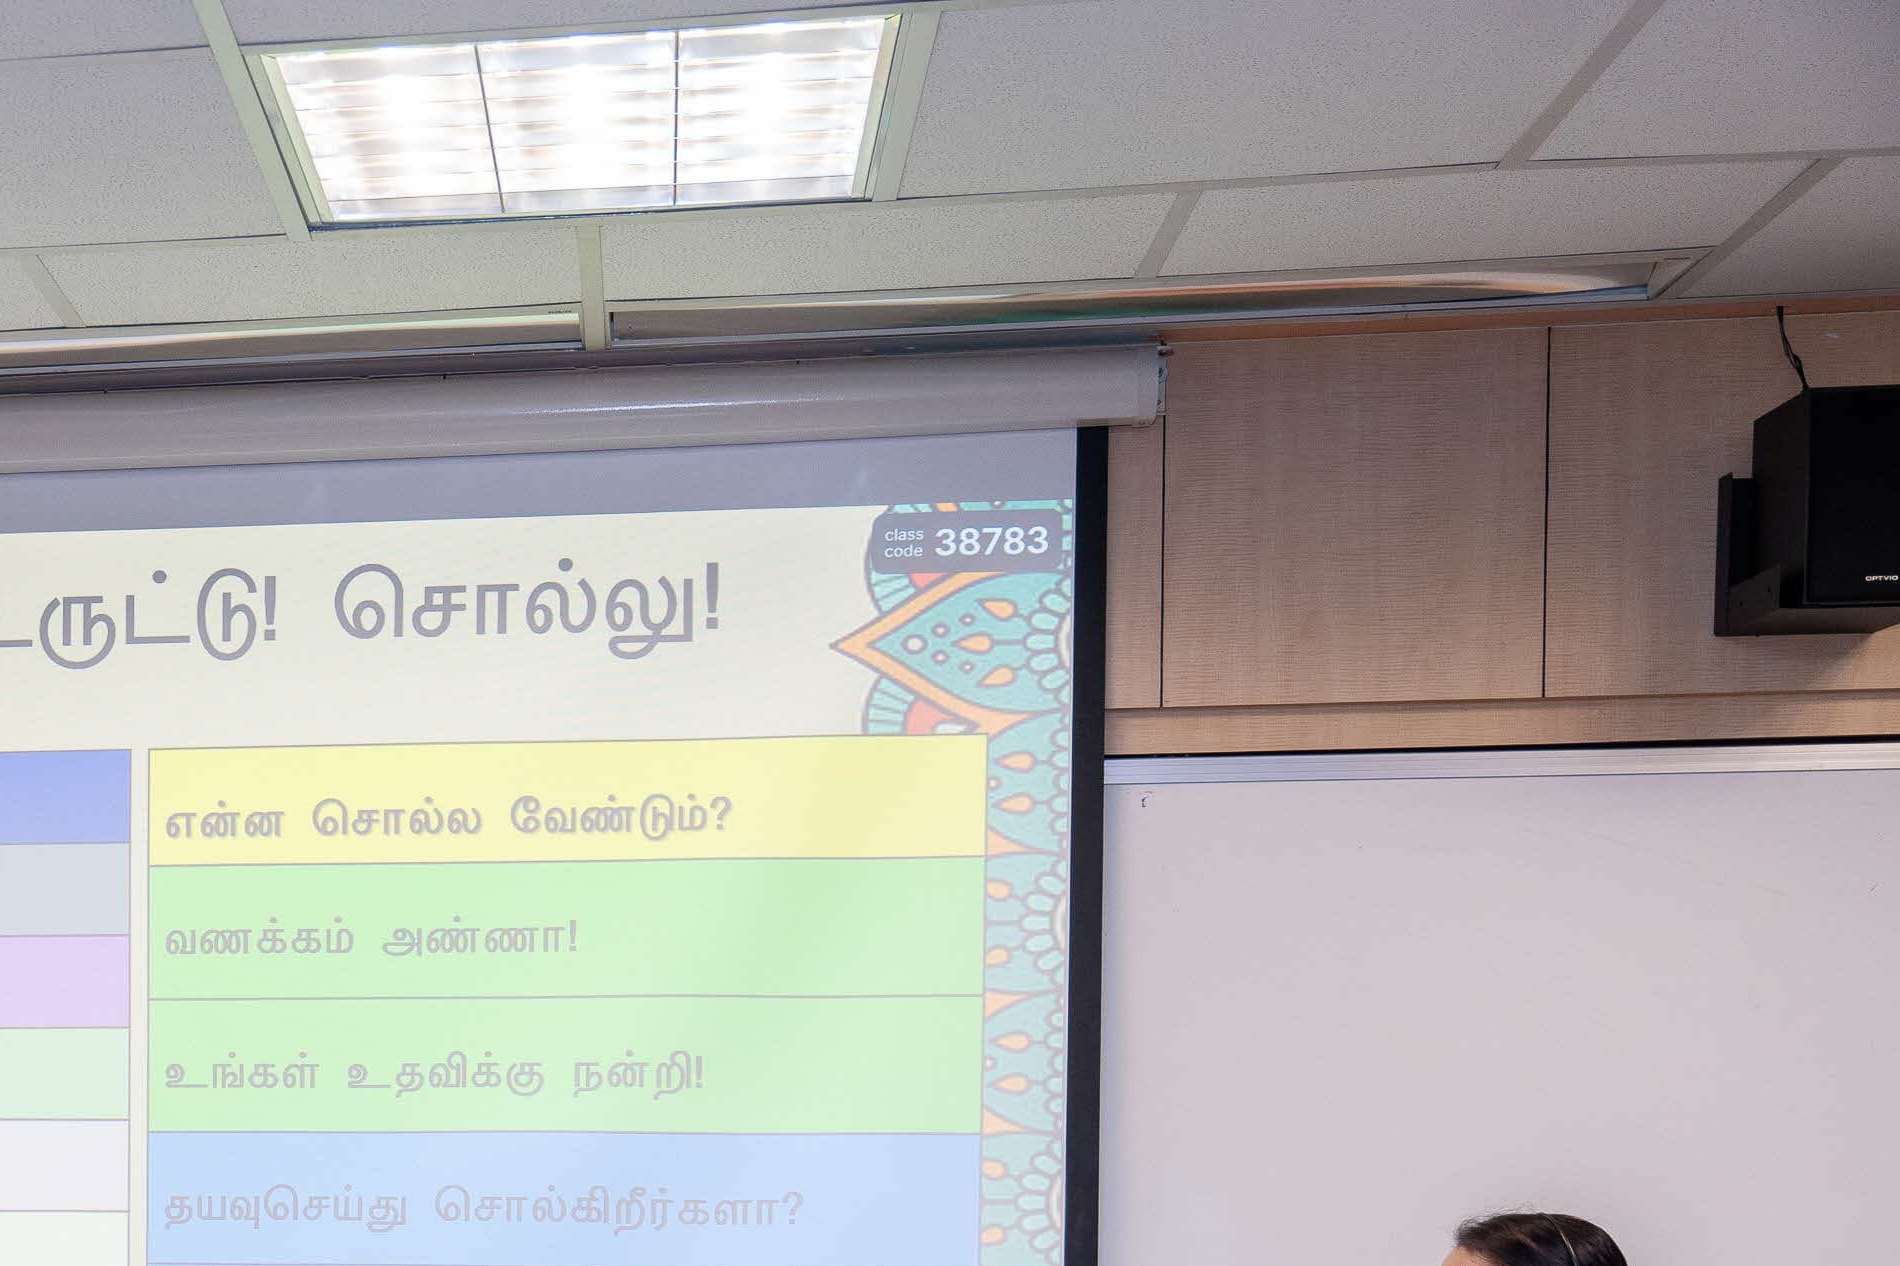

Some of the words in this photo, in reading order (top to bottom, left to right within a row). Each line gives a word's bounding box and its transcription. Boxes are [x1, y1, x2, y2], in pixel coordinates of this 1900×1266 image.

[884, 544, 924, 558] code
[885, 529, 924, 541] class
[936, 526, 1048, 556] 38783
[334, 558, 719, 659] சொல்லு!
[166, 800, 284, 838] என்ன
[312, 796, 482, 836] சொல்ல
[510, 793, 732, 841] வேண்டும்?
[165, 916, 354, 955] வணக்கம்
[382, 915, 577, 956] அண்ணா!
[165, 1052, 319, 1088] உங்கள்
[348, 1051, 544, 1098] உதவிக்கு
[574, 1050, 703, 1100] நன்றி!
[165, 1184, 406, 1233] தயவுசெய்து
[435, 1184, 804, 1237] சொல்கிறீர்களா?
